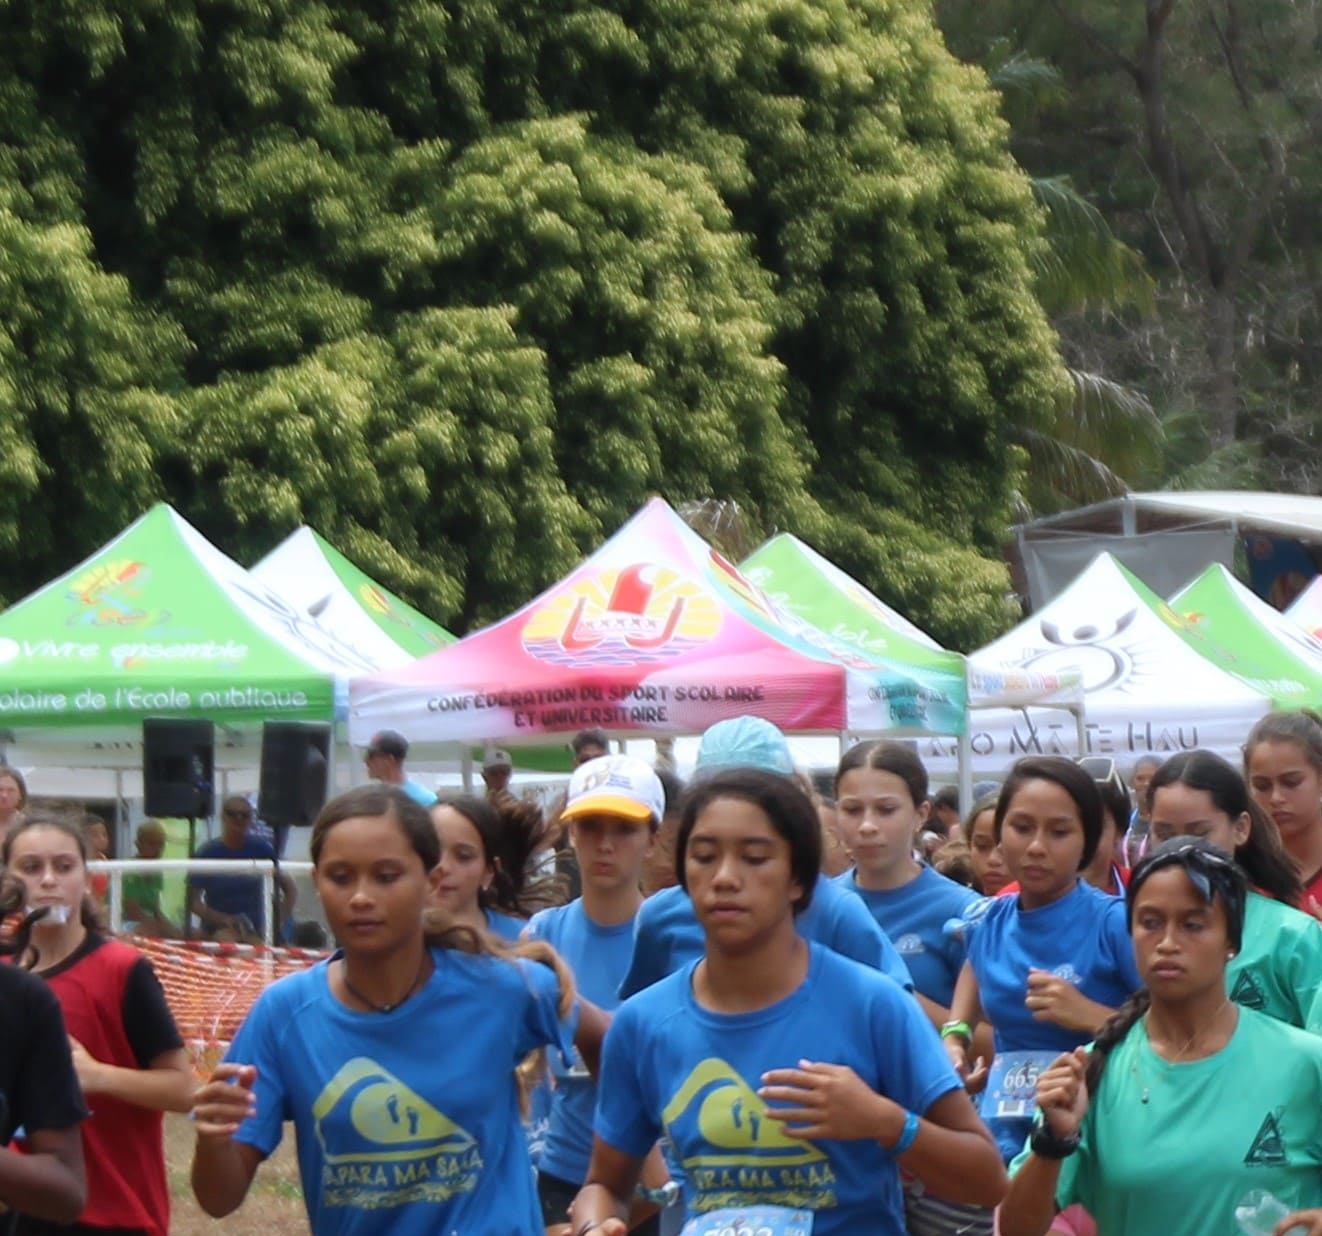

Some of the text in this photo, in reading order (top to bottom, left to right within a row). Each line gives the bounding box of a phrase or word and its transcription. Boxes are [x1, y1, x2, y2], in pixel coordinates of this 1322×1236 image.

[74, 687, 107, 710] de
[198, 686, 310, 712] publique
[607, 685, 671, 703] SPORT
[673, 684, 766, 703] SCOLAIRE
[513, 704, 670, 728] ET UNIVERSITAIRE
[1003, 1065, 1042, 1091] 665
